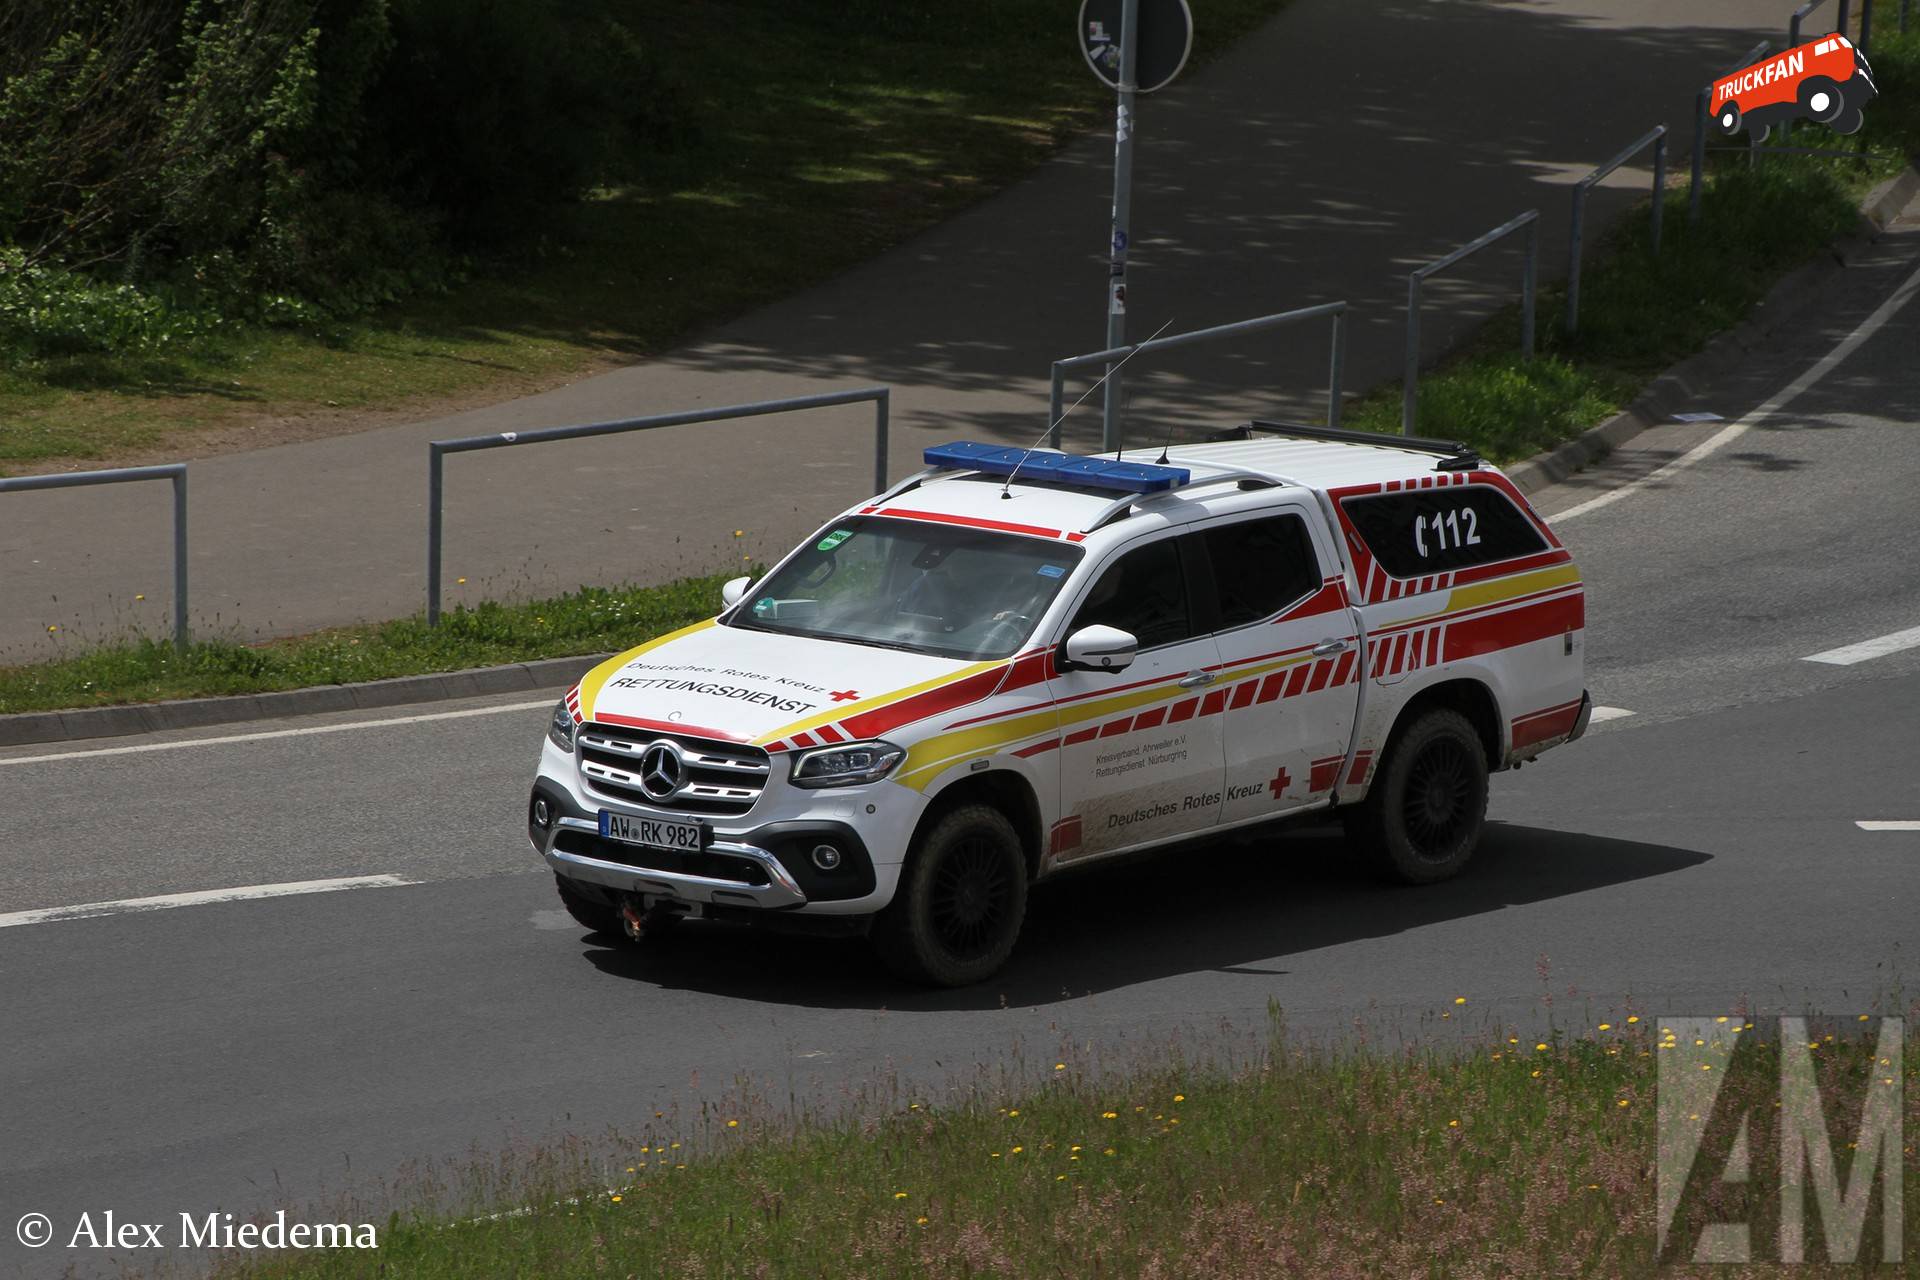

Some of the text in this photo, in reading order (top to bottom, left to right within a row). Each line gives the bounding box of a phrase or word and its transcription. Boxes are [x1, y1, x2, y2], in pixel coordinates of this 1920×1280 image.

[1432, 507, 1481, 550] 112
[627, 662, 828, 694] Deutsches Rotes Kreuz
[609, 677, 818, 715] RETTUNGSDIENST
[1096, 745, 1140, 765] Kreisverband
[1142, 738, 1174, 754] Ahrweiler
[1095, 758, 1145, 779] Rettungsdienst
[1108, 782, 1264, 828] Deutsches Rotes Kreuz
[610, 816, 630, 839] AW
[641, 821, 663, 844] RK
[666, 825, 699, 849] 982
